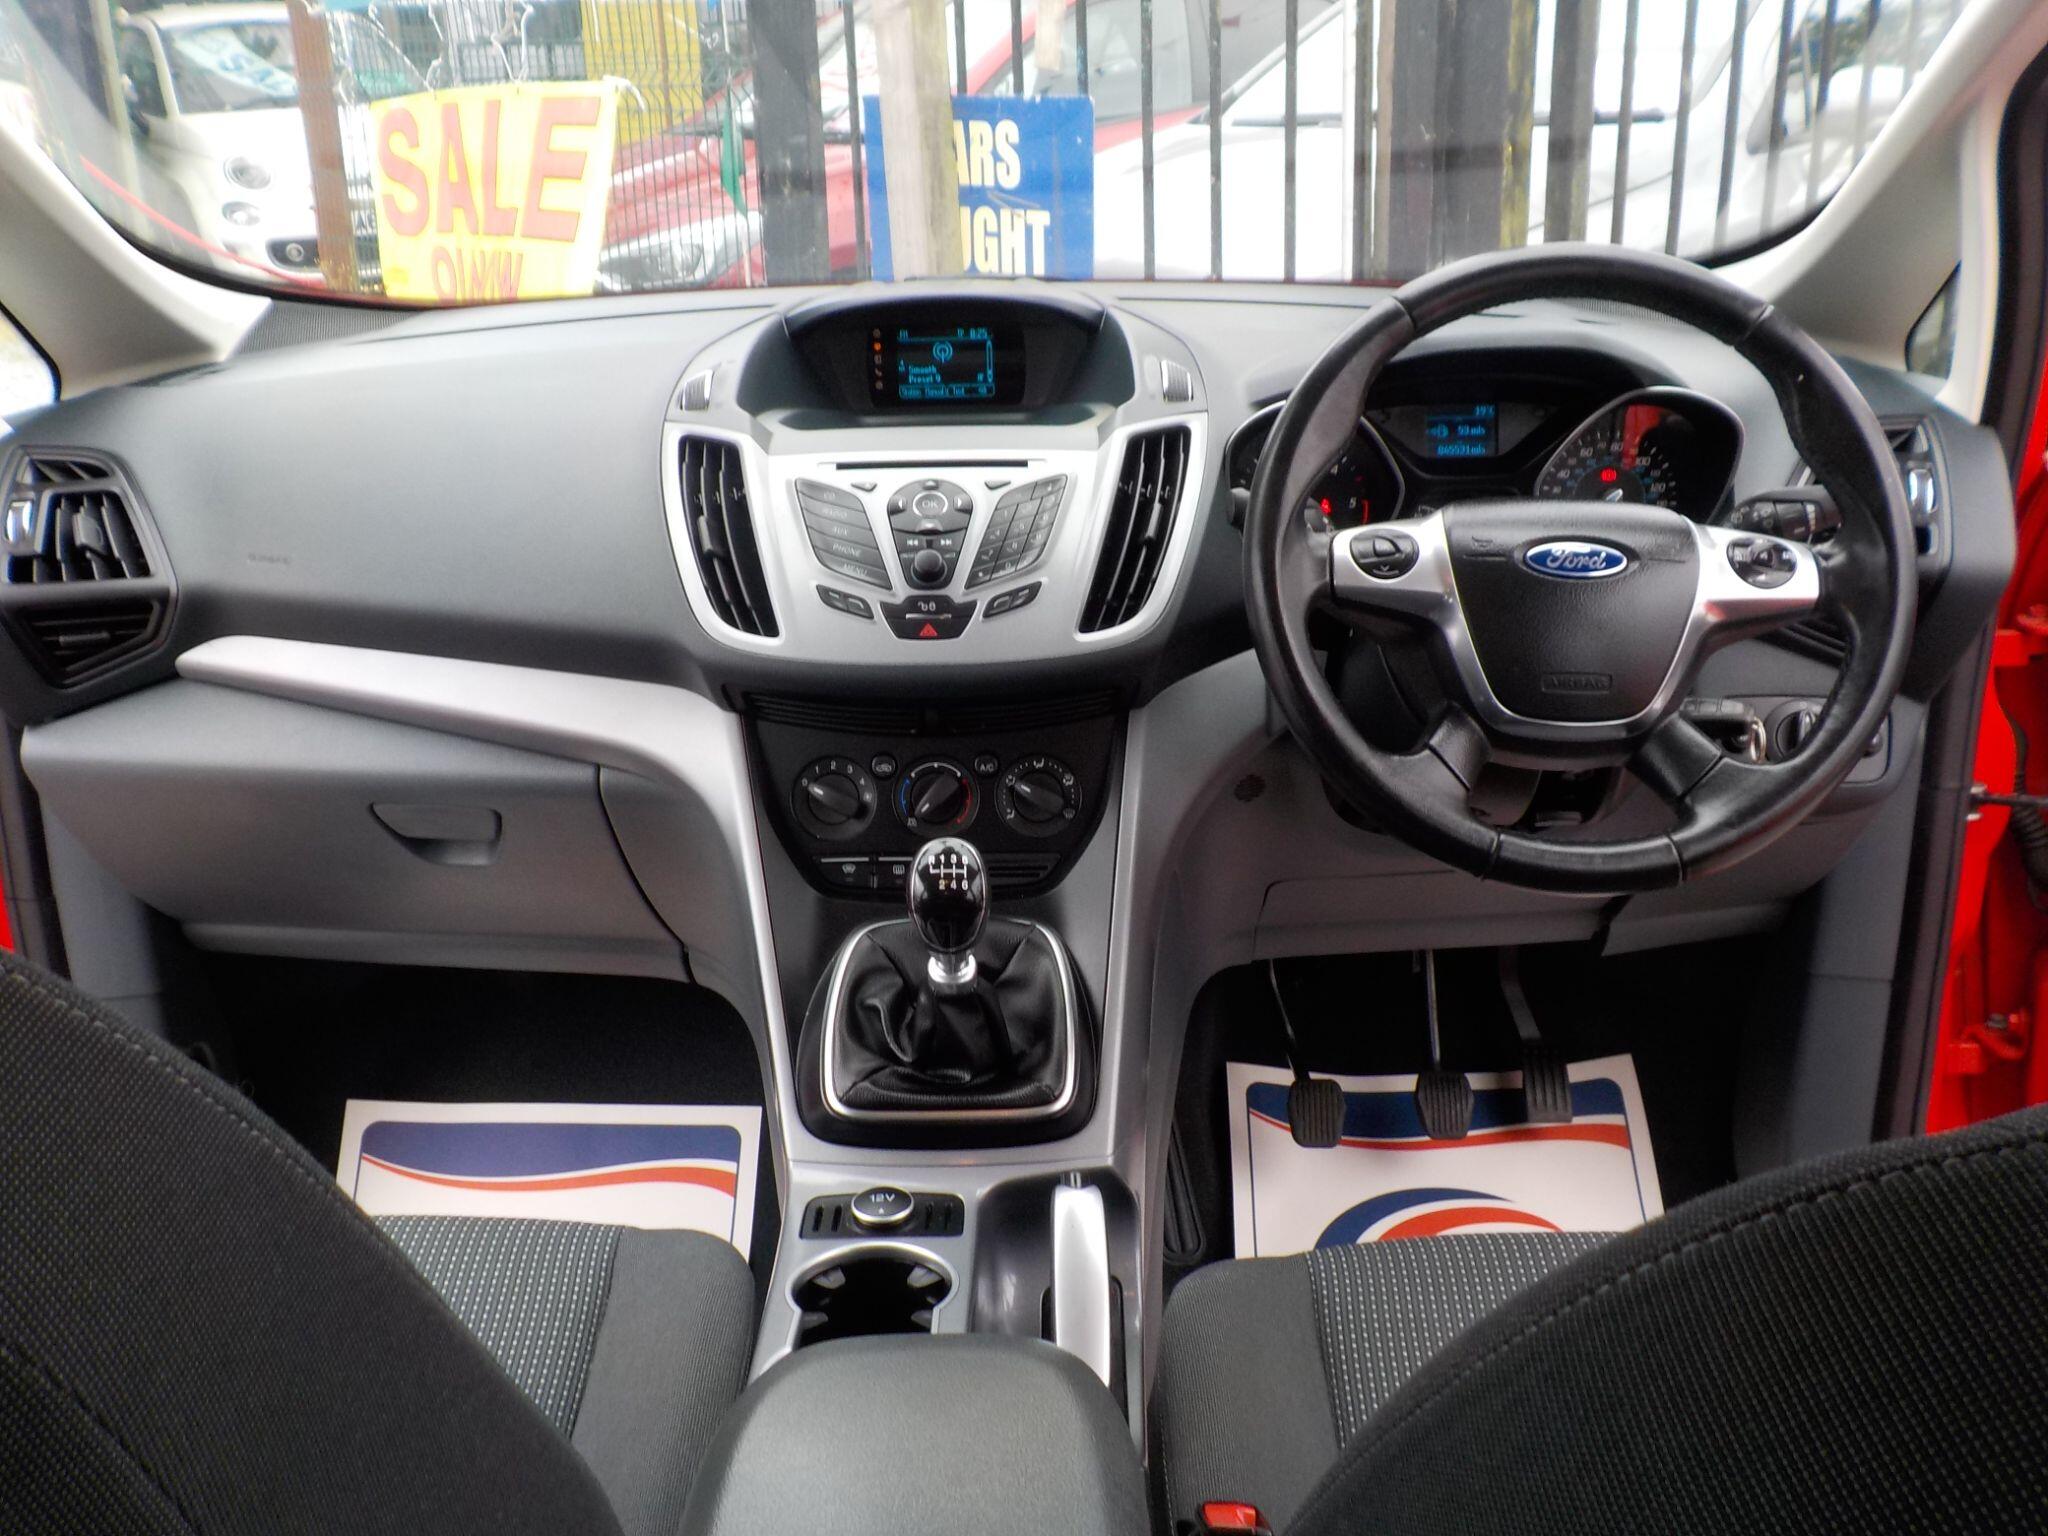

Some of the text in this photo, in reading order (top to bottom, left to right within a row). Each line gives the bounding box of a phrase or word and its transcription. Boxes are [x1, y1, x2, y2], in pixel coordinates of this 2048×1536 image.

[378, 96, 601, 243] SALE
[921, 499, 940, 509] OK
[1546, 548, 1607, 569] Ford
[950, 880, 957, 891] 4
[961, 880, 969, 891] 6
